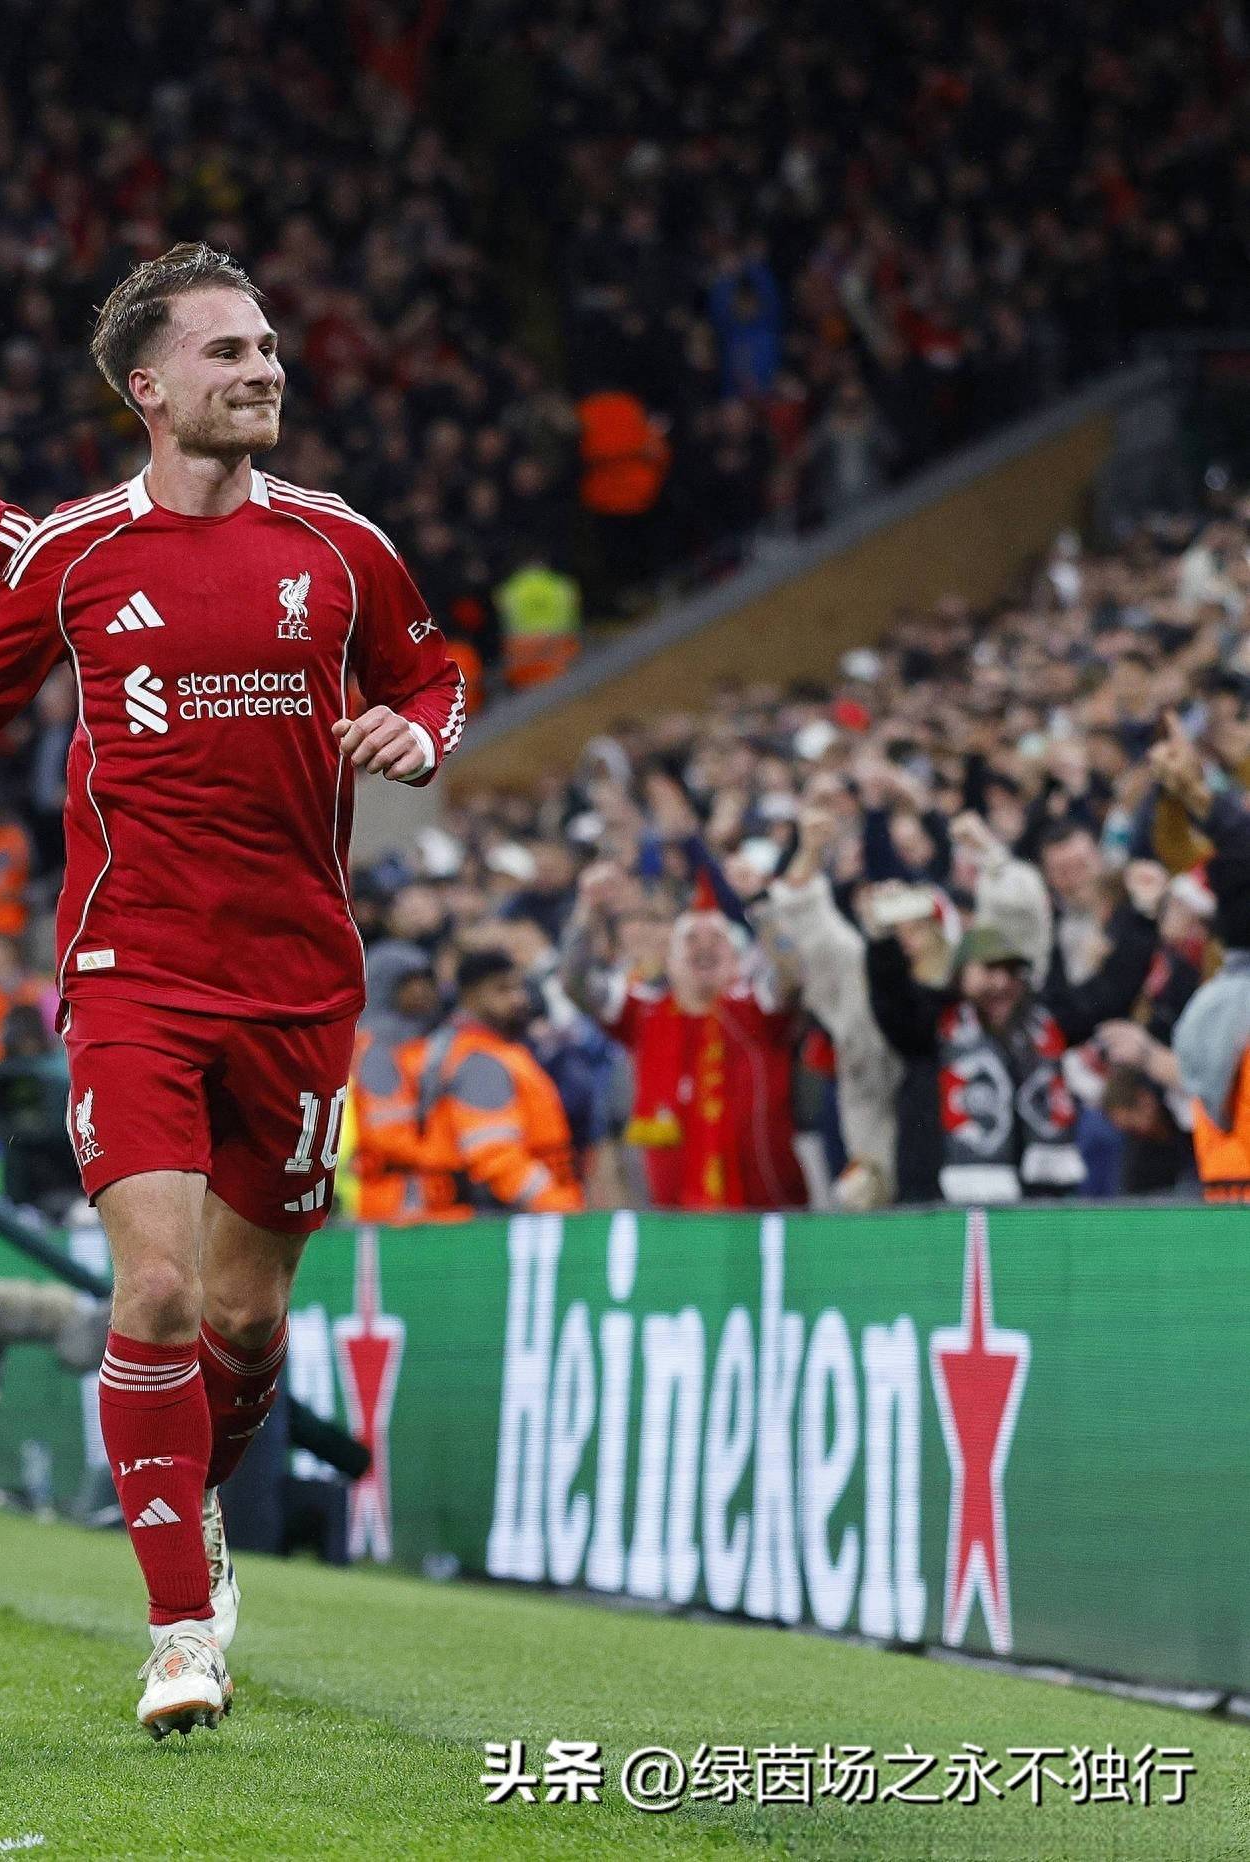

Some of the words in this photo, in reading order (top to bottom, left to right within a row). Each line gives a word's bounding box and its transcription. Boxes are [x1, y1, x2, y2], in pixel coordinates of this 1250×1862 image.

[177, 668, 306, 696] standard
[179, 692, 313, 720] chartered
[285, 1085, 348, 1173] 10
[486, 1210, 927, 1643] Heineken
[118, 1456, 174, 1477] LFC
